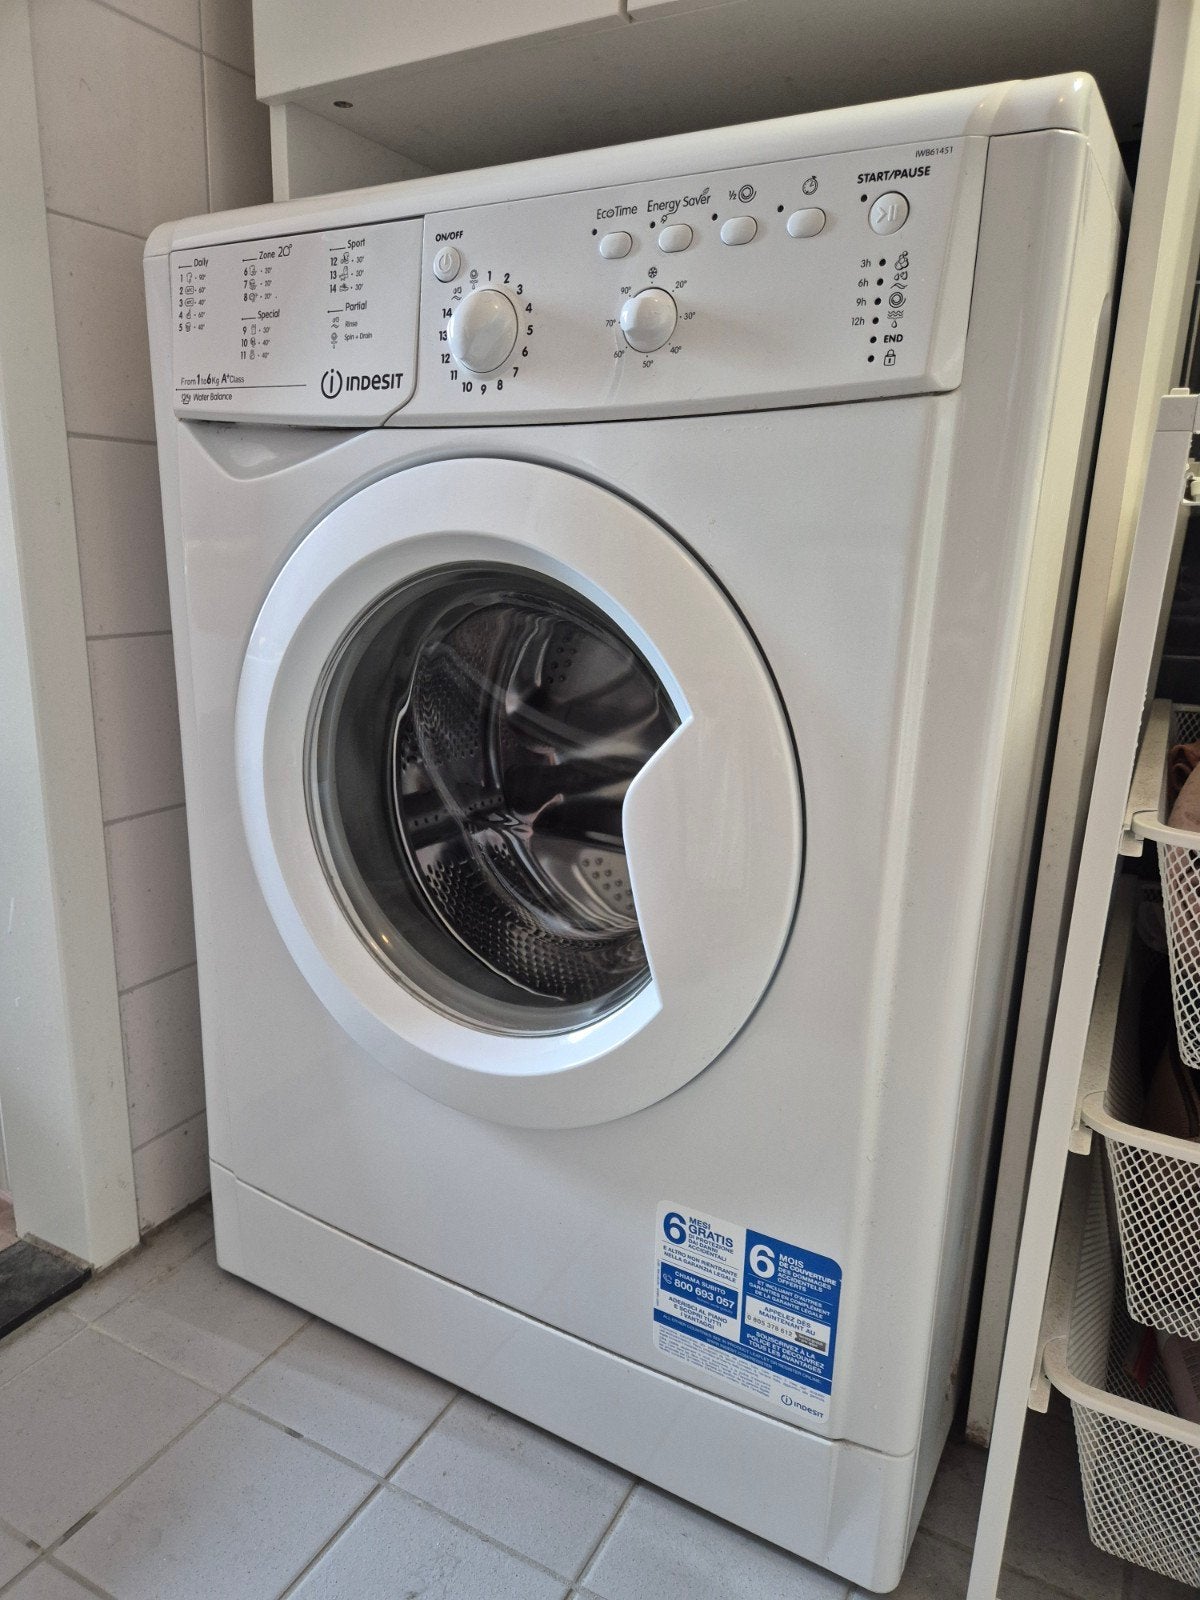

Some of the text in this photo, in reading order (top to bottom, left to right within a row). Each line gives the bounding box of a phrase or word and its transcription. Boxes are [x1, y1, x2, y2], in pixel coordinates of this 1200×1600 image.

[916, 146, 953, 158] IWB61451
[857, 166, 930, 184] START/PAUSE
[647, 194, 711, 213] Energy Saver
[596, 205, 638, 220] EcoTime
[436, 230, 464, 242] ON/OFF
[348, 238, 366, 250] Sport
[259, 244, 292, 260] Zone 20°
[194, 258, 208, 267] Daily
[330, 257, 338, 266] 12
[860, 259, 872, 268] 3h
[244, 268, 248, 276] 6
[330, 270, 337, 280] 13
[488, 271, 492, 281] 1
[504, 273, 510, 284] 2
[858, 278, 868, 287] 6h
[244, 280, 248, 289] 7
[330, 284, 336, 293] 14
[516, 284, 522, 295] 3
[180, 287, 184, 295] 2
[179, 299, 183, 307] 3
[244, 293, 248, 302] 8
[856, 298, 866, 306] 9h
[346, 301, 368, 311] Partial
[526, 303, 532, 314] 4
[179, 312, 183, 320] 4
[258, 309, 280, 320] Special
[442, 308, 452, 318] 14
[852, 318, 865, 326] 12h
[178, 324, 182, 332] 5
[242, 326, 246, 334] 9
[527, 324, 534, 336] 5
[344, 333, 354, 341] Spin
[439, 330, 448, 341] 13
[884, 334, 904, 343] END
[242, 339, 248, 348] 10
[240, 351, 246, 360] 11
[522, 346, 528, 357] 6
[442, 354, 450, 364] 12
[450, 370, 458, 380] 11
[513, 367, 519, 378] 7
[181, 377, 196, 385] From
[196, 374, 200, 385] 1
[206, 373, 212, 384] 6
[212, 377, 220, 386] Kg
[230, 375, 244, 384] Class
[346, 373, 404, 392] INDESIT
[497, 380, 503, 390] 8
[462, 382, 472, 392] 10
[481, 384, 487, 394] 9
[193, 392, 232, 401] Water Balance
[664, 1212, 686, 1244] 6
[689, 1217, 710, 1230] MESI
[689, 1225, 734, 1248] GRATIS
[696, 1236, 734, 1254] PROTEZIONE
[700, 1243, 718, 1253] DANNI
[688, 1245, 726, 1262] ACCIDENTALI
[668, 1247, 686, 1258] ALTRO
[687, 1254, 700, 1262] NON
[701, 1260, 738, 1277] RIENTRANTE
[750, 1244, 775, 1278] 6
[780, 1254, 804, 1268] MOIS
[664, 1252, 737, 1282] NELLA GARANZIA LEGALE
[778, 1267, 832, 1290] DES DOMMAGES
[790, 1265, 836, 1286] COUVERTURE
[674, 1271, 726, 1295] CHIAMA SUBITO
[778, 1273, 822, 1292] ACCIDENTELS
[778, 1278, 807, 1292] OFFERTS
[674, 1278, 693, 1292] 800
[695, 1288, 714, 1300] 693
[716, 1296, 734, 1309] 057
[748, 1282, 780, 1298] GARANTIES
[765, 1282, 793, 1297] INCLUANT
[794, 1294, 822, 1308] D'AUTRES
[772, 1296, 800, 1310] GARANTIE
[669, 1296, 698, 1312] ADERISCI
[708, 1312, 728, 1324] PIANO
[764, 1306, 795, 1322] APPELEZ
[680, 1306, 702, 1319] SCOPRI
[704, 1316, 722, 1327] TUTTI
[684, 1314, 714, 1330] VANTAGGI
[759, 1310, 804, 1331] MAINTENANT
[747, 1333, 772, 1347] POLICE
[756, 1332, 800, 1353] SOUSCRIVEZ
[749, 1340, 823, 1374] TOUS LES AVANTAGES
[794, 1402, 824, 1418] INDESIT
